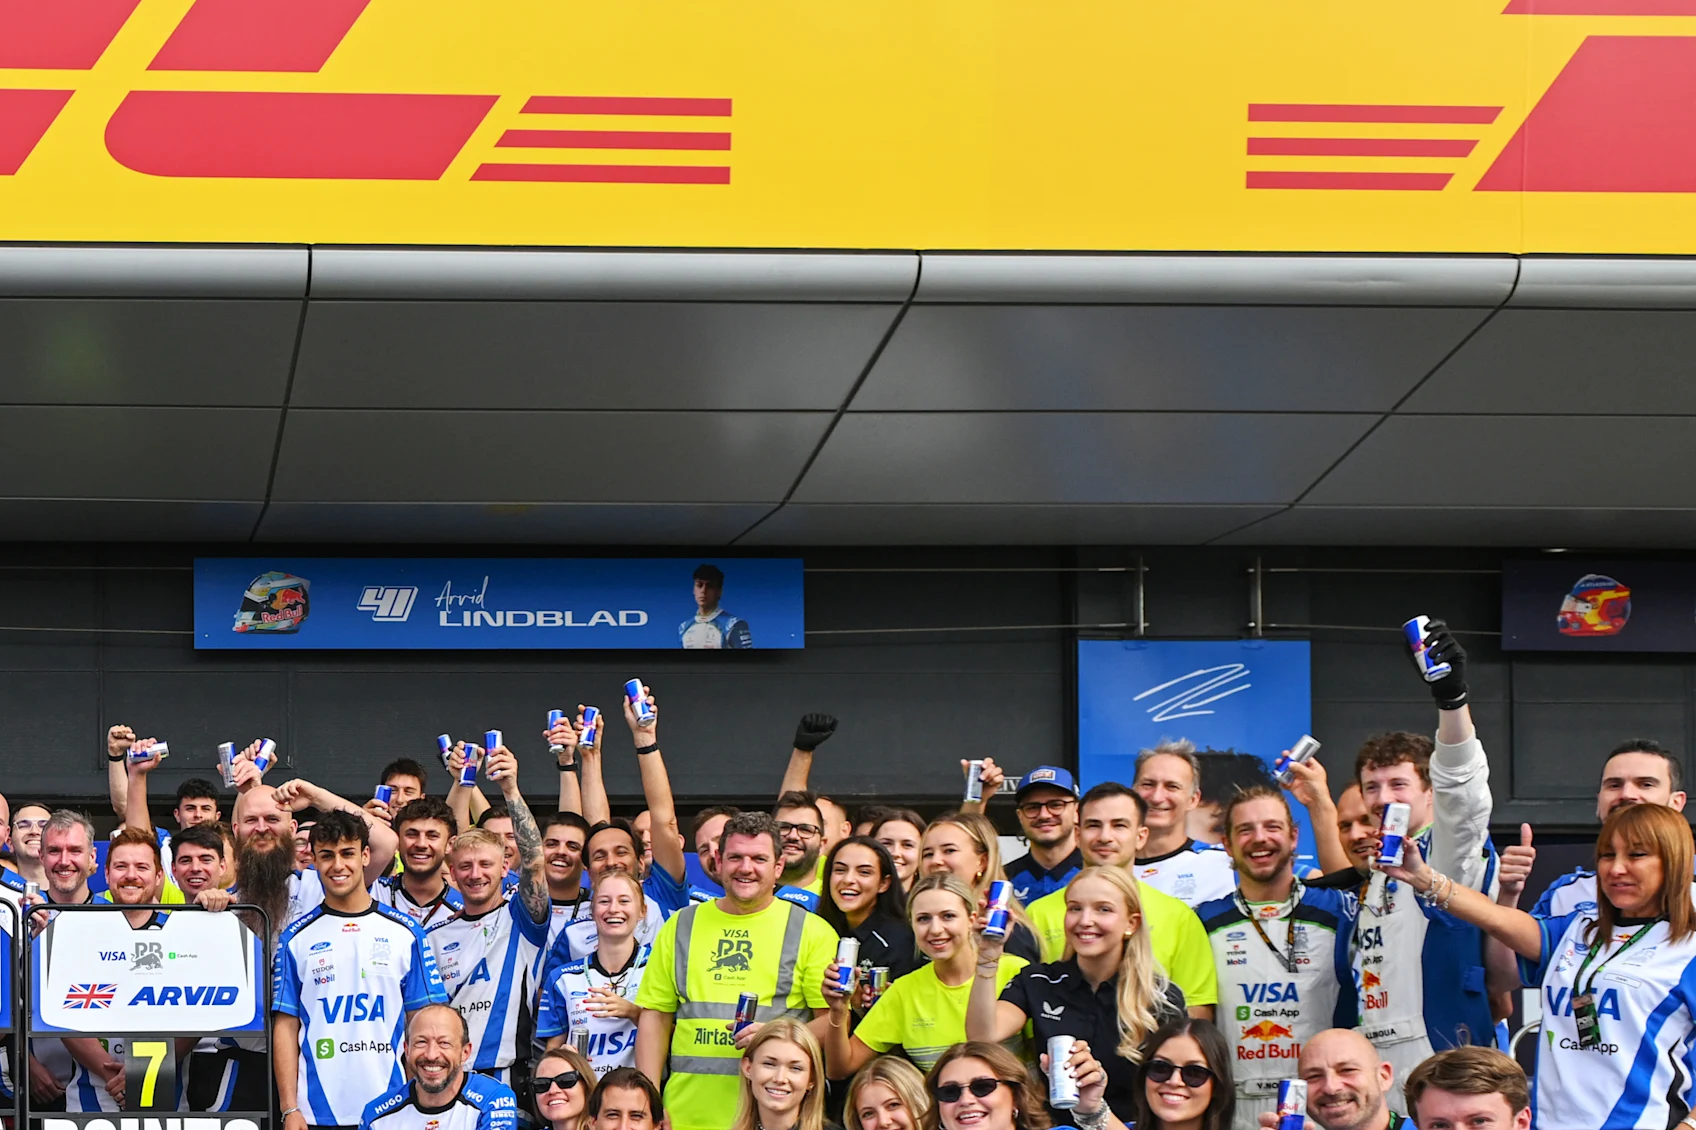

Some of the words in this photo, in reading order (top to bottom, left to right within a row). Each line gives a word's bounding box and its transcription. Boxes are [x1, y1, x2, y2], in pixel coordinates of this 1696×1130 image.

[357, 585, 418, 621] 41
[262, 610, 284, 623] Red
[284, 606, 303, 620] Bull
[439, 610, 648, 627] LINDBLAD
[783, 893, 809, 901] HUGO
[289, 913, 313, 934] HUGO
[388, 910, 415, 928] HUGO
[722, 929, 749, 938] VISA
[98, 951, 127, 961] VISA
[312, 965, 334, 974] TUDOR
[314, 974, 335, 985] Mobil
[127, 986, 239, 1006] ARVID
[1237, 983, 1300, 1004] VISA
[1367, 992, 1388, 1010] Bull
[317, 993, 384, 1024] VISA
[469, 1000, 492, 1012] App
[1254, 1008, 1278, 1017] Cash
[1280, 1008, 1300, 1018] App
[694, 1028, 735, 1046] Airtas
[340, 1040, 369, 1053] Cash
[370, 1041, 392, 1054] App
[1237, 1045, 1266, 1060] Red
[1268, 1044, 1300, 1059] Bull
[131, 1041, 167, 1107] 7
[375, 1094, 403, 1115] HUGO
[489, 1097, 516, 1108] VISA
